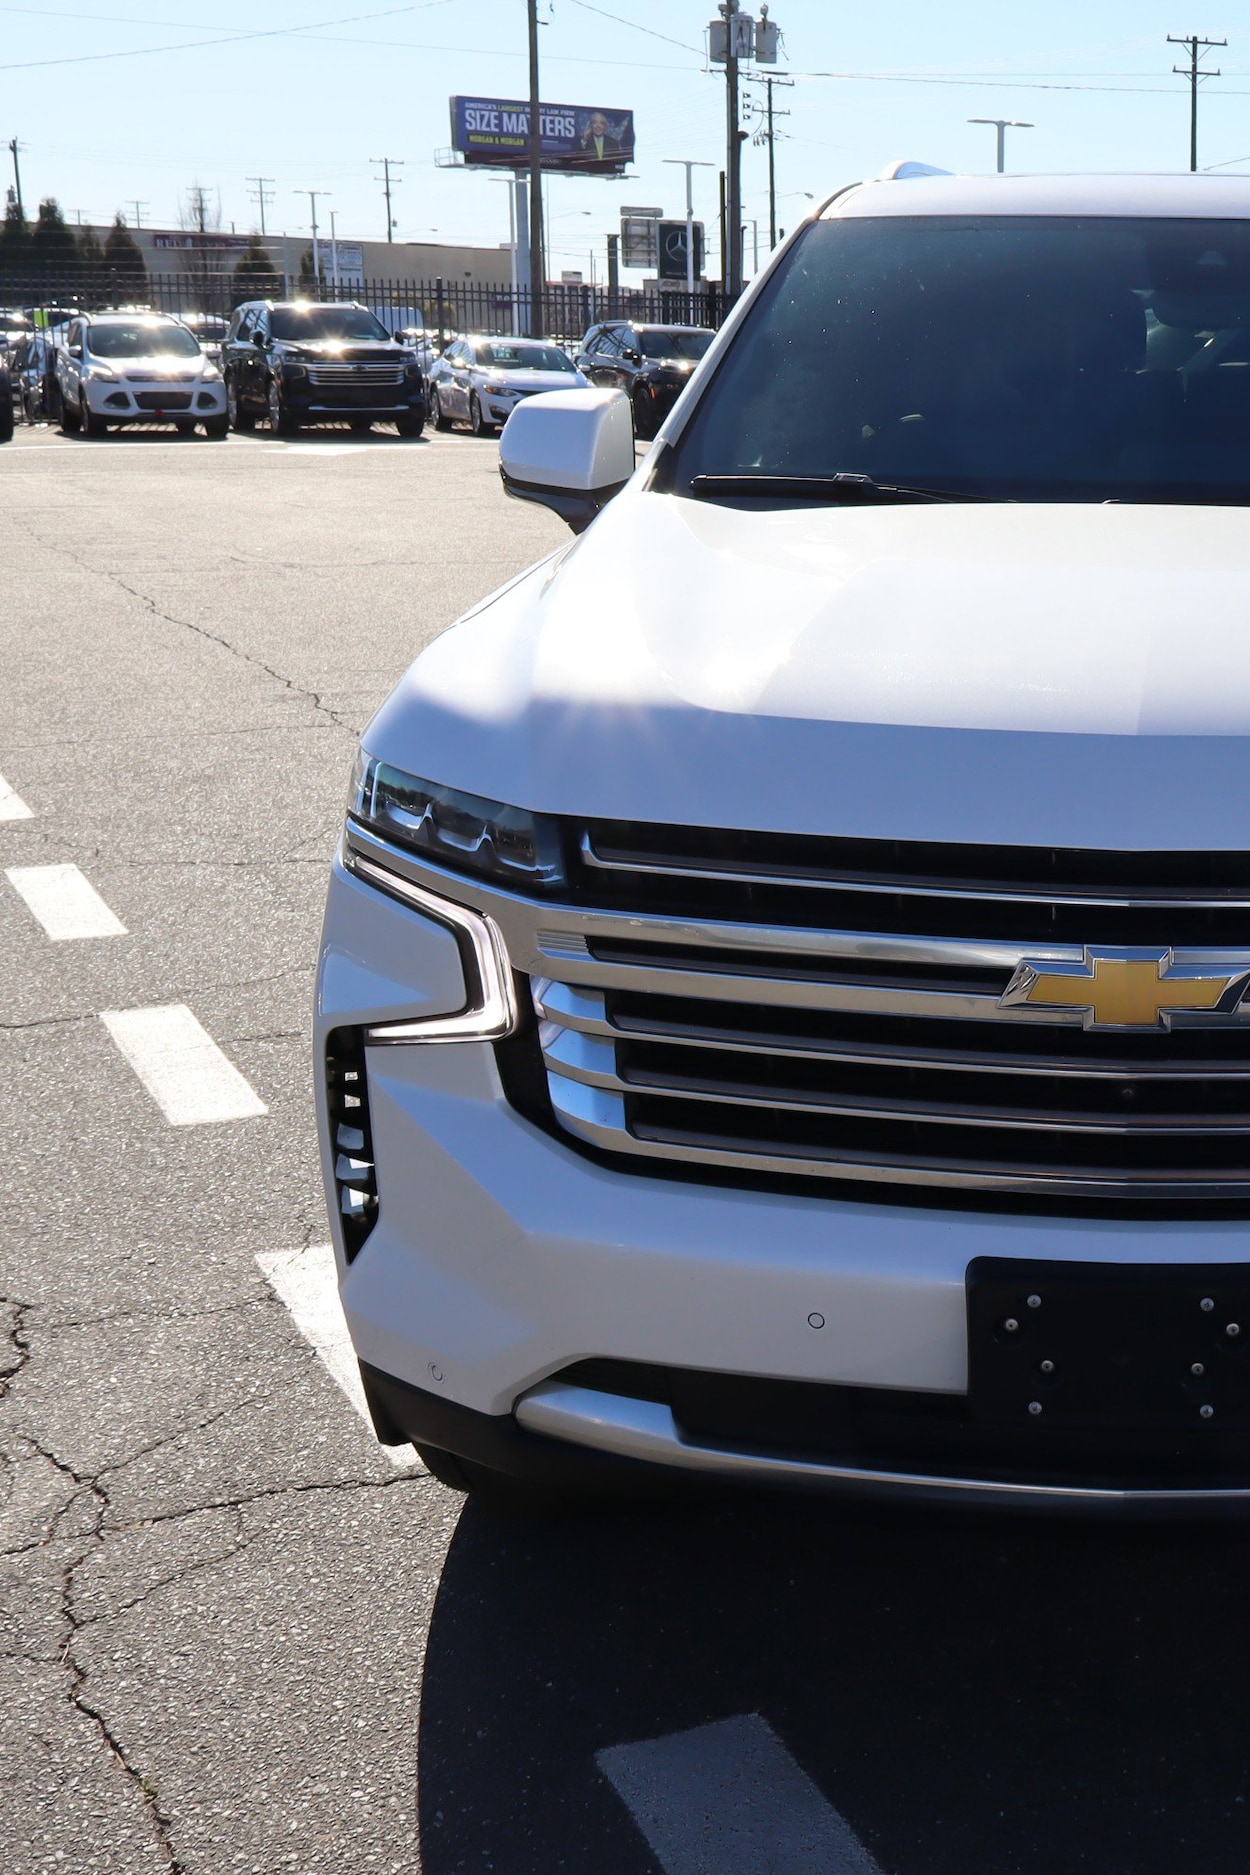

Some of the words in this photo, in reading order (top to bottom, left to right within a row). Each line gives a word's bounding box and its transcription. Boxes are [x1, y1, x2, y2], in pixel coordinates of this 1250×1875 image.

[524, 106, 545, 114] INRY
[465, 110, 499, 132] SIZE
[502, 112, 575, 138] MATERS
[469, 134, 494, 144] MORGAN
[500, 137, 525, 146] MORGAN
